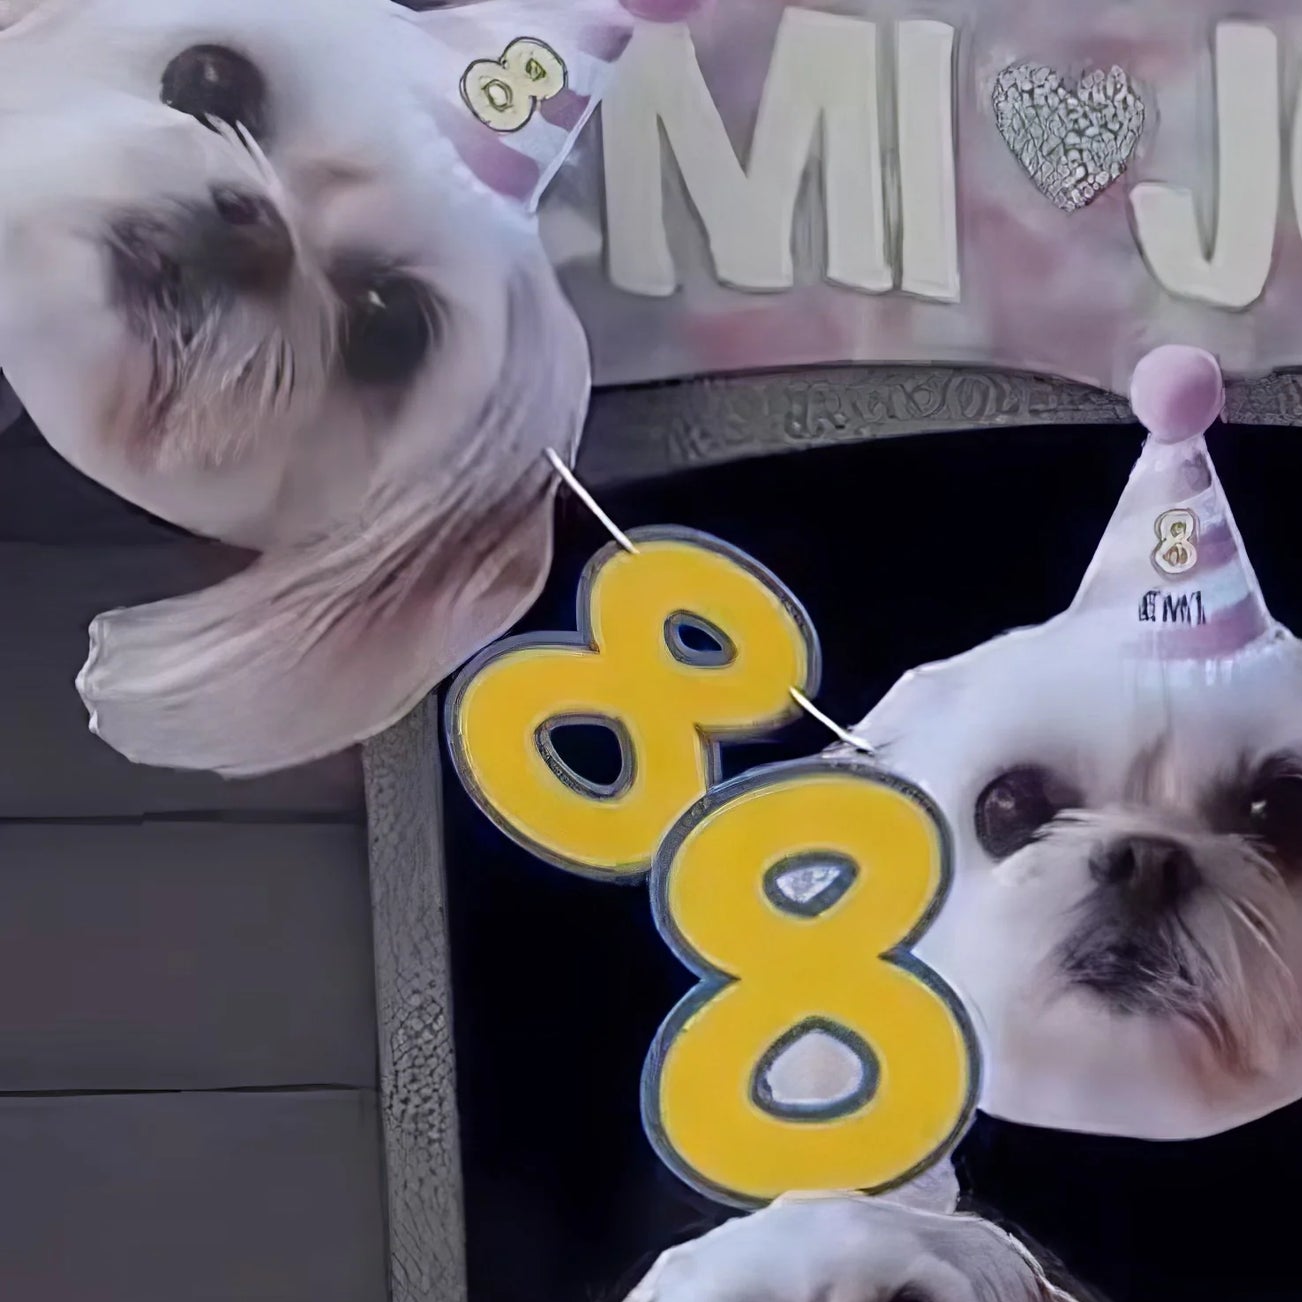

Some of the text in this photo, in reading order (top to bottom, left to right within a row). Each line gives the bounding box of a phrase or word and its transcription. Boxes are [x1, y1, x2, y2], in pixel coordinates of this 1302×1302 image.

[459, 36, 568, 133] 8
[540, 7, 961, 303] MI
[1150, 507, 1200, 580] 8
[447, 527, 820, 880] 8
[642, 760, 984, 1208] 8
